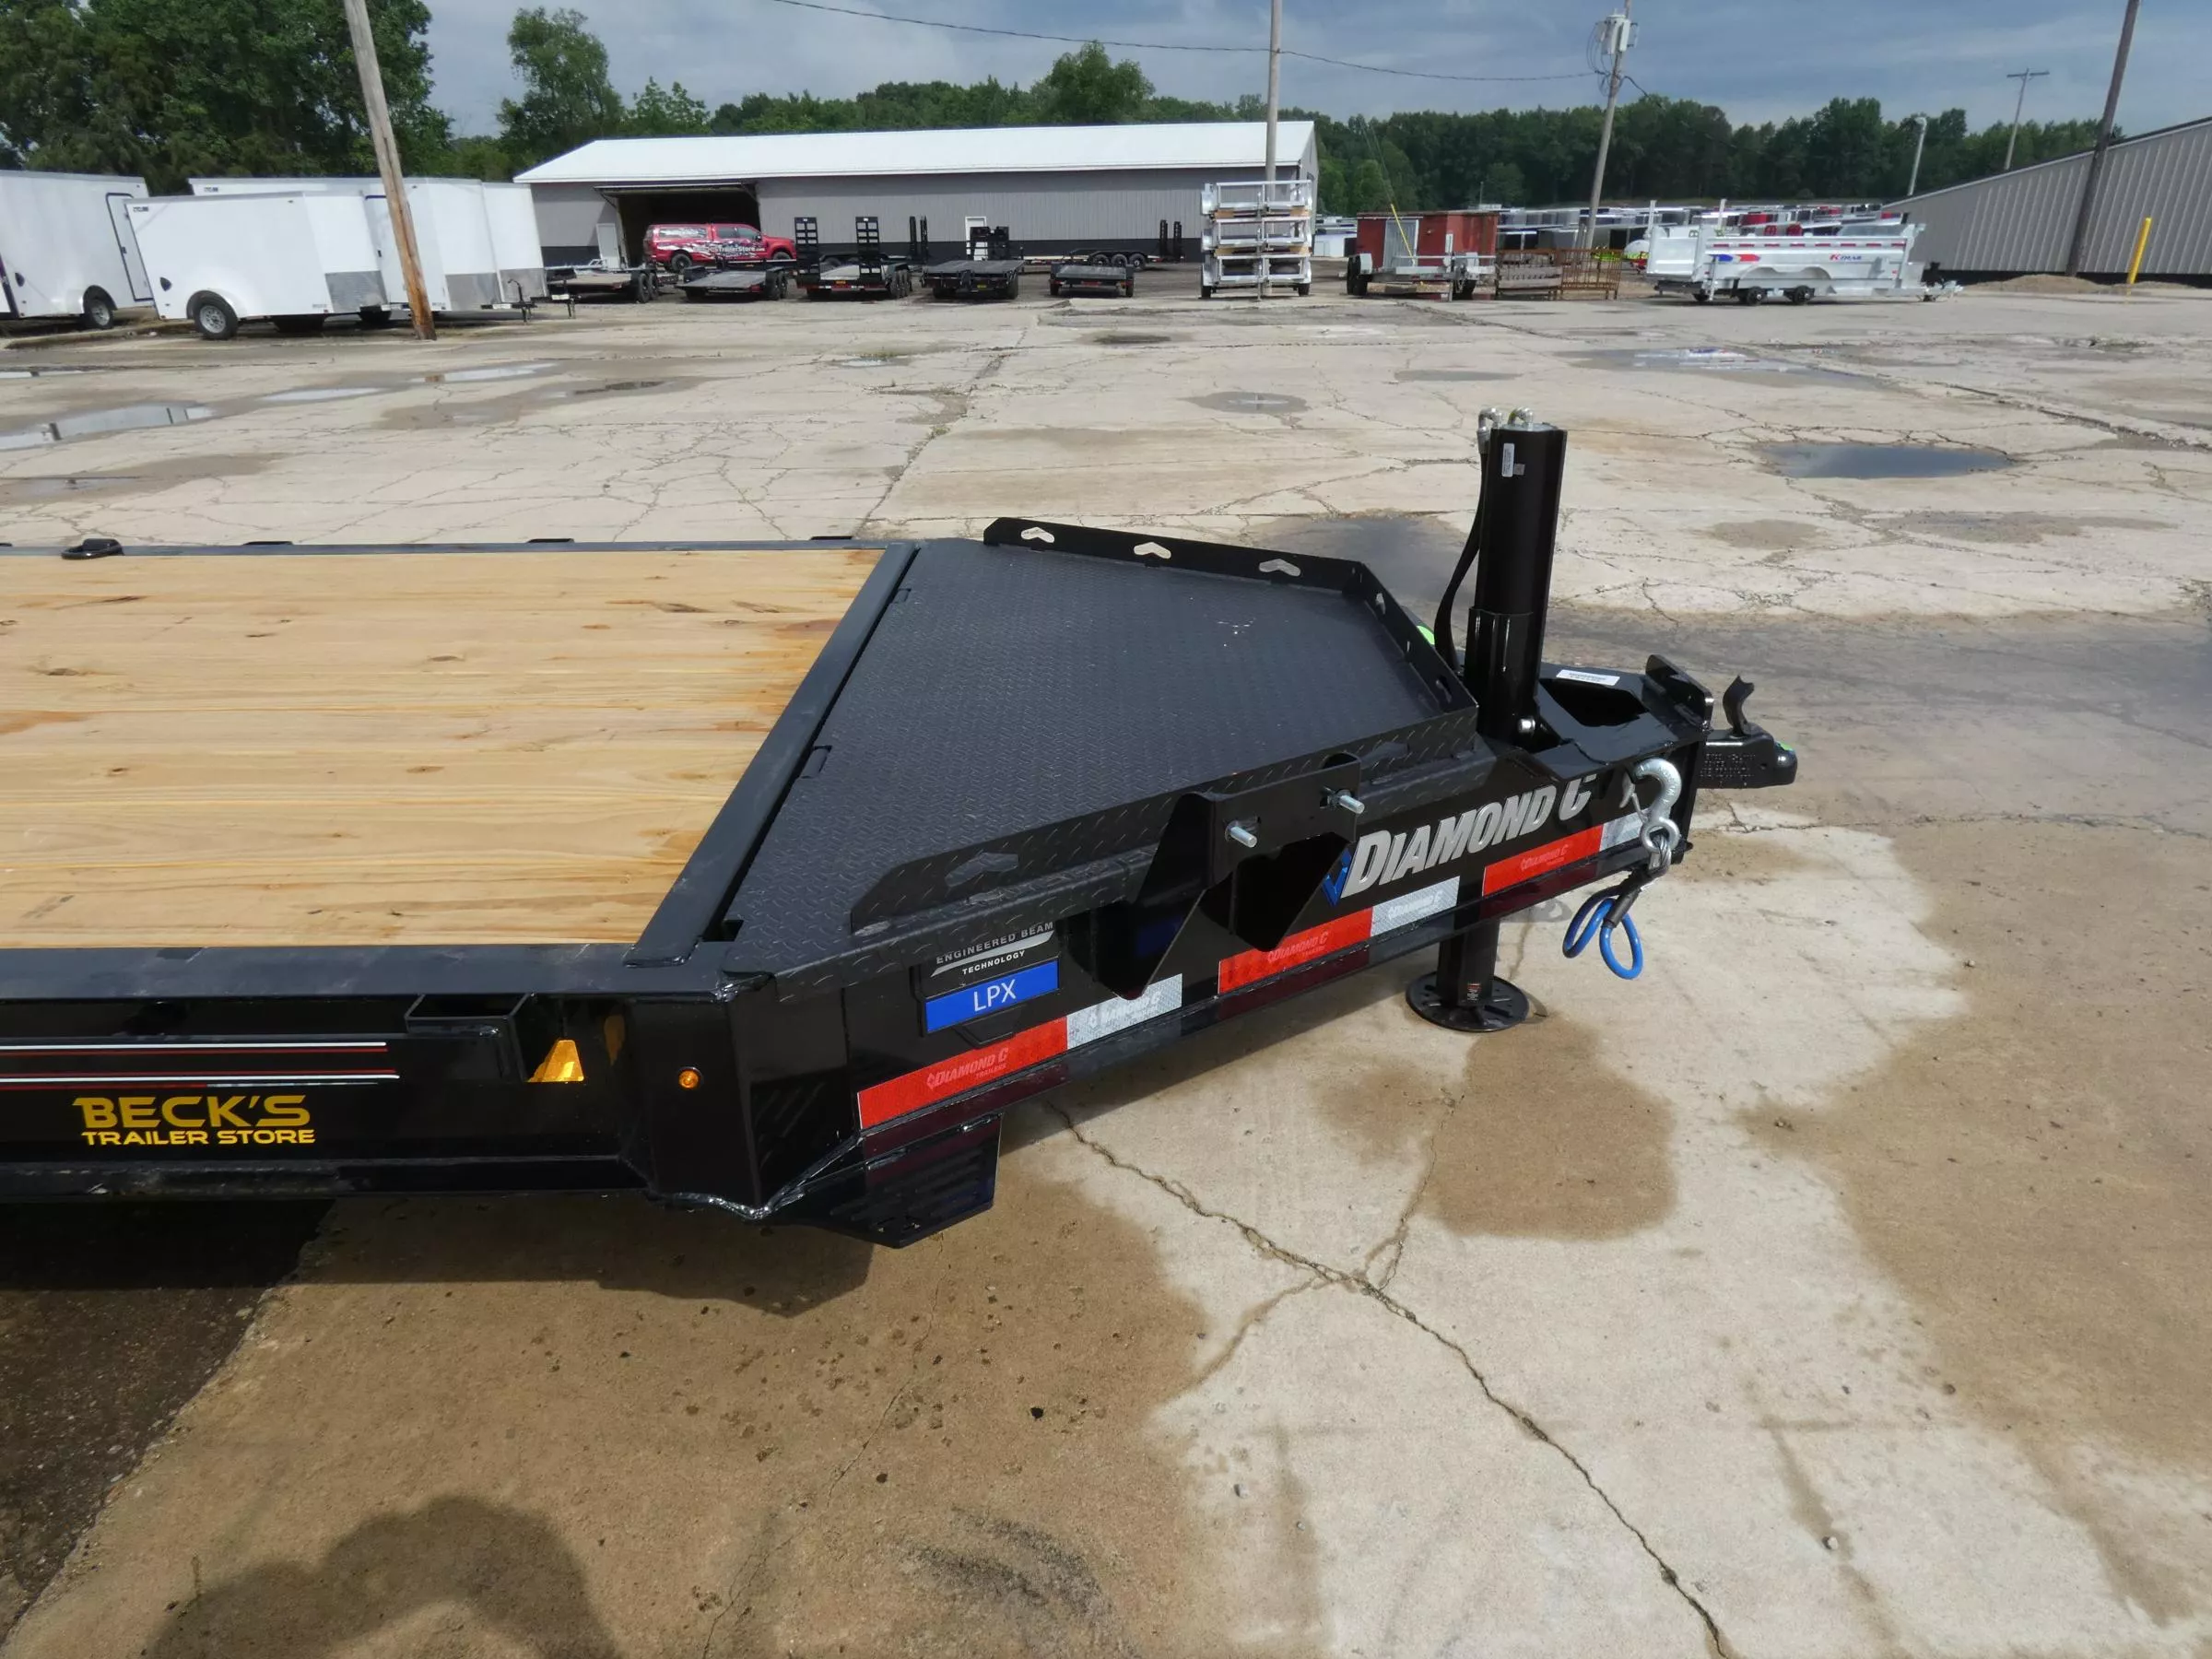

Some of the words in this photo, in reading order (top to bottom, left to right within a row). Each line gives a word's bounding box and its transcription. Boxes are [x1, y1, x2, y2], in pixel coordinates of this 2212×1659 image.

[1340, 784, 1557, 899] DIAMOND
[1558, 773, 1597, 821] C
[936, 933, 1017, 965] ENGINEERED
[1020, 921, 1053, 939] BEAM
[962, 949, 1025, 975] TECHNOLOGY
[973, 979, 1017, 1012] LPX
[934, 1053, 996, 1088] DIAMOND
[998, 1047, 1009, 1063] C
[72, 1094, 311, 1129] BECK'S
[81, 1129, 209, 1146] TRAILER
[217, 1129, 315, 1145] STORE
